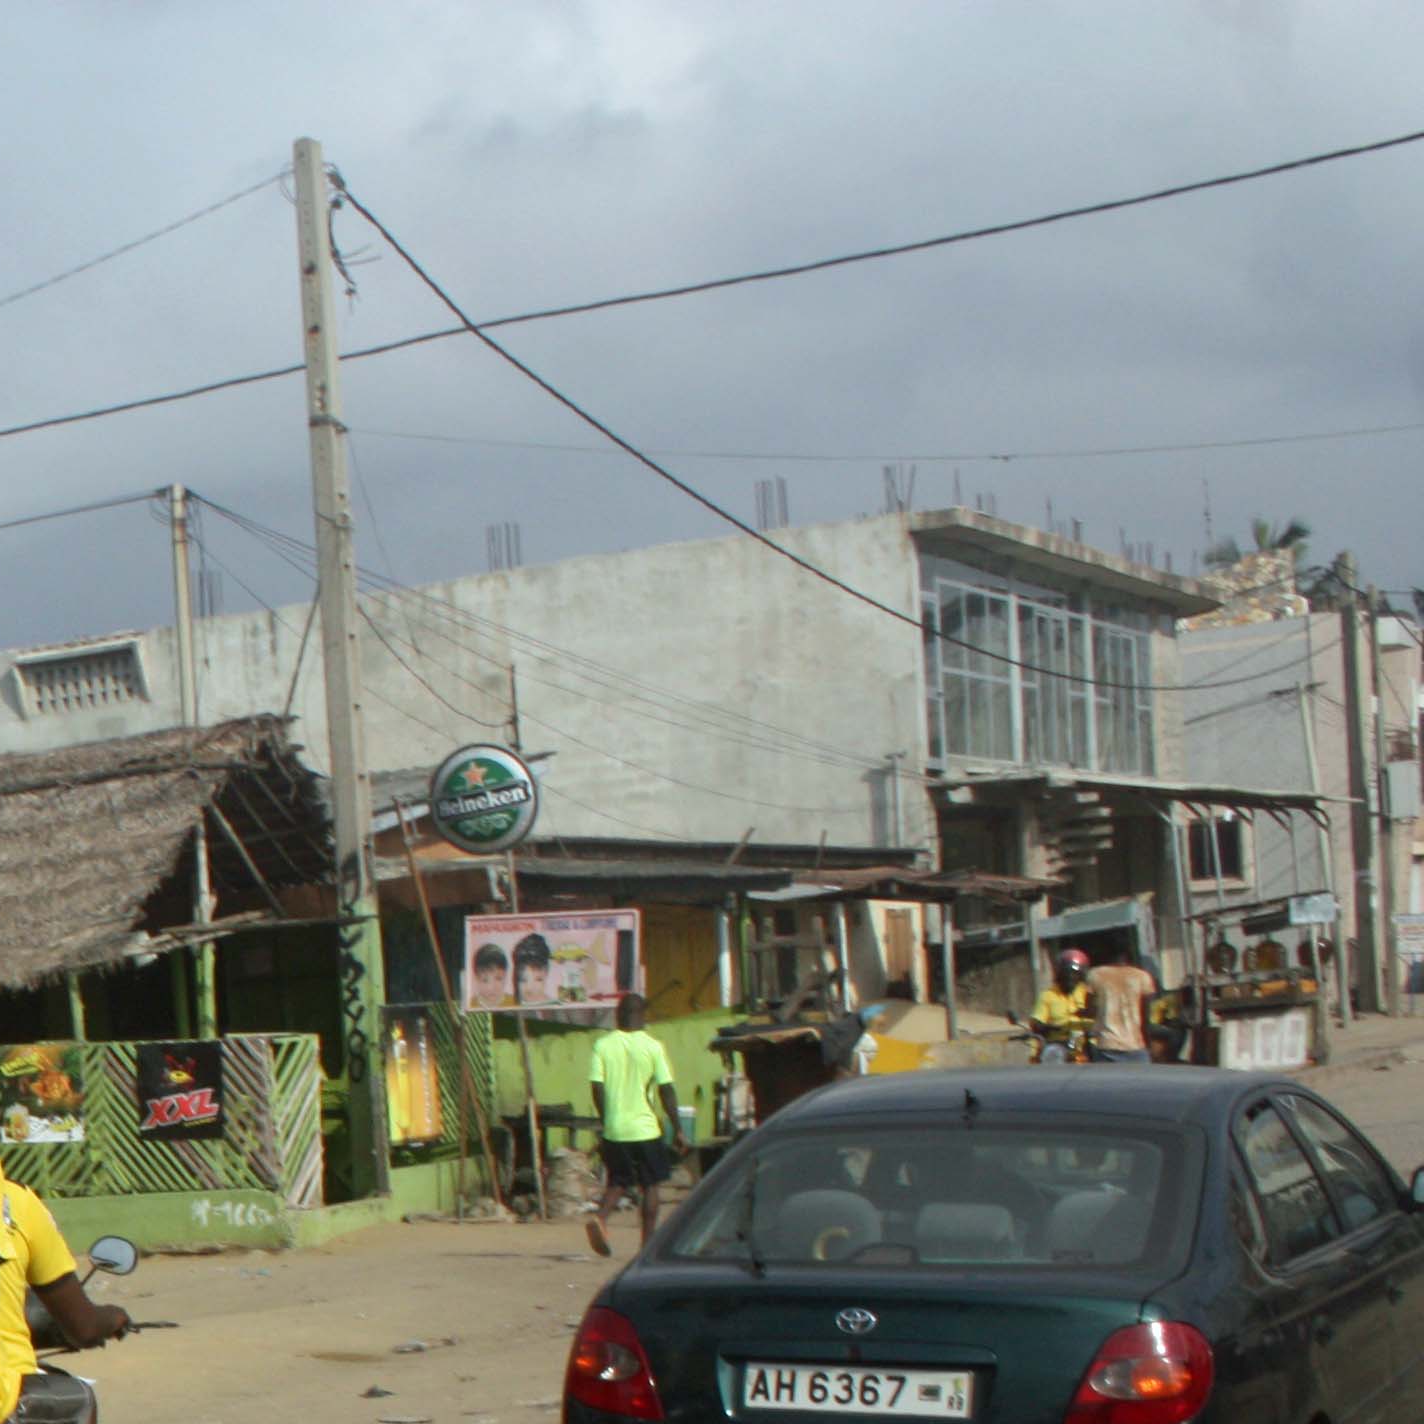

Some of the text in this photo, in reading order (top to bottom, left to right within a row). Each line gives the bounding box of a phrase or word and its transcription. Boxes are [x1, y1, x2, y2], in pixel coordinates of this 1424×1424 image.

[438, 786, 528, 818] Heineken
[140, 1088, 219, 1131] XXL
[751, 1368, 908, 1408] AH 6367
